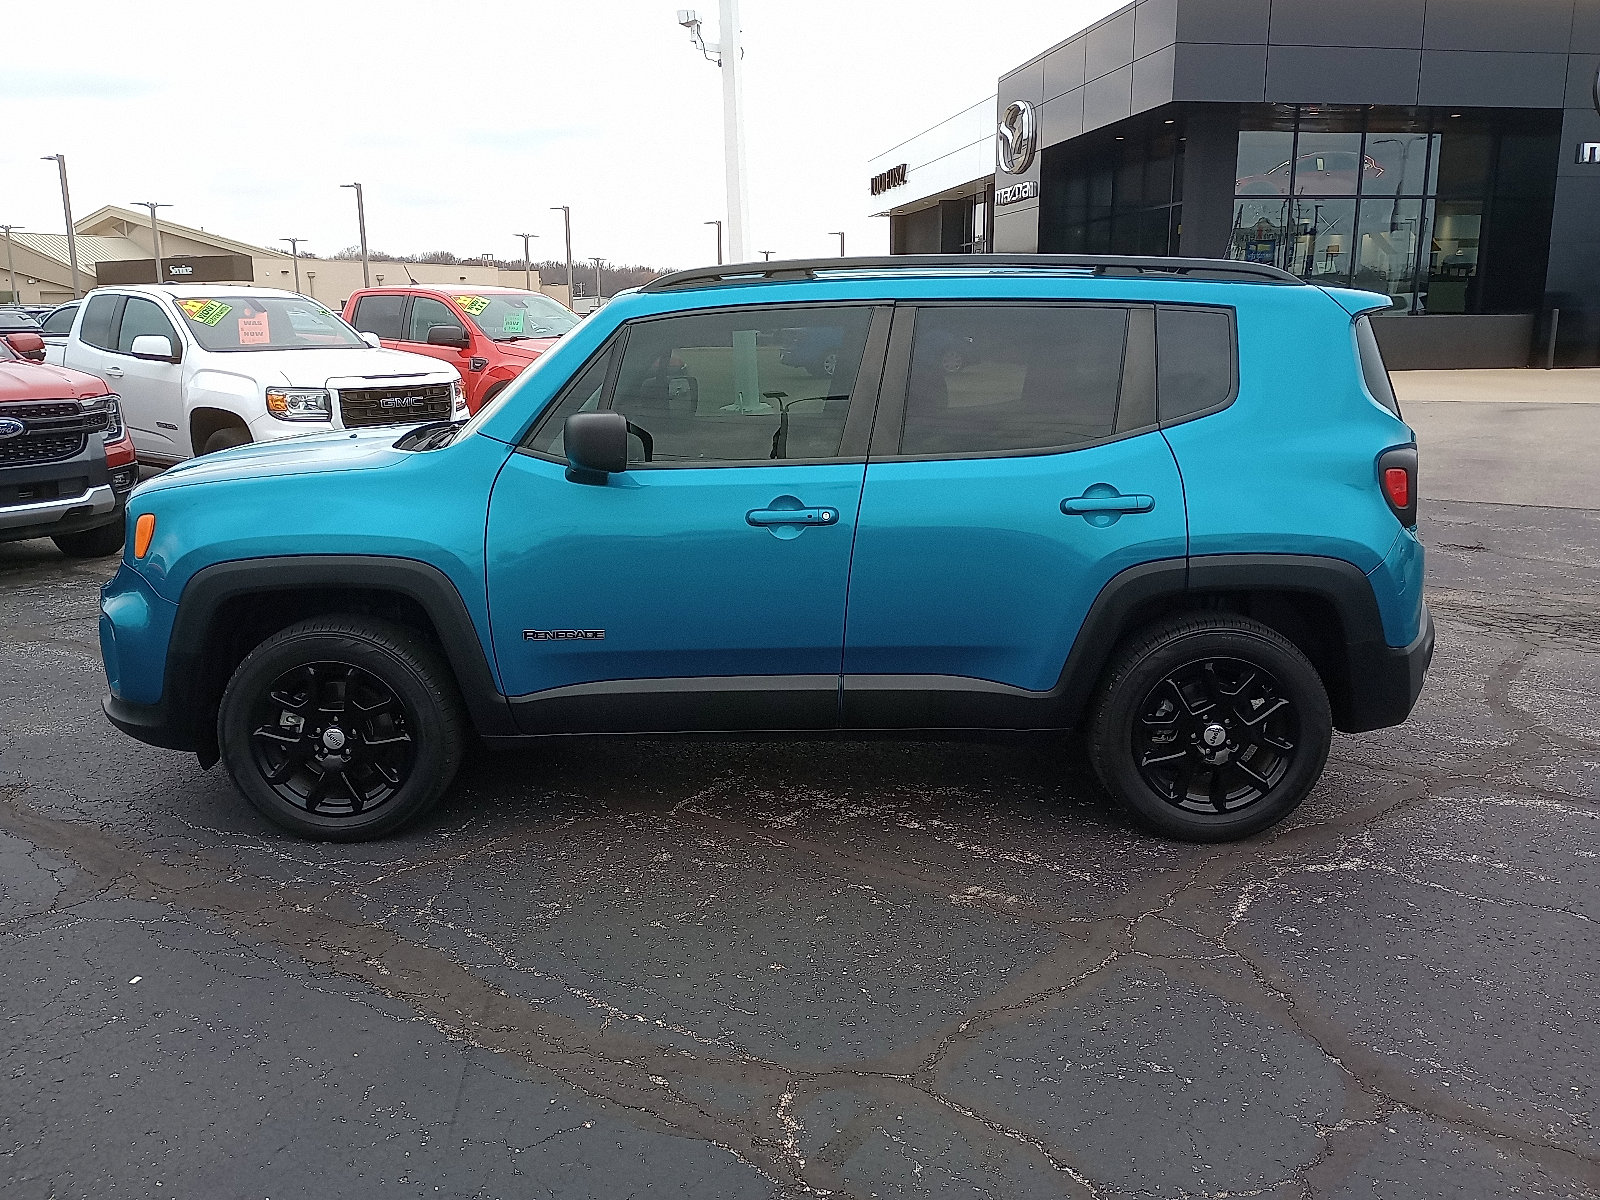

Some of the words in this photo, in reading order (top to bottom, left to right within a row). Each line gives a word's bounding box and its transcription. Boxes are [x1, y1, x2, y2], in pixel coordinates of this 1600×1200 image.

[380, 396, 424, 408] GMC
[523, 629, 605, 641] RENEGADE
[326, 732, 342, 747] Jeep
